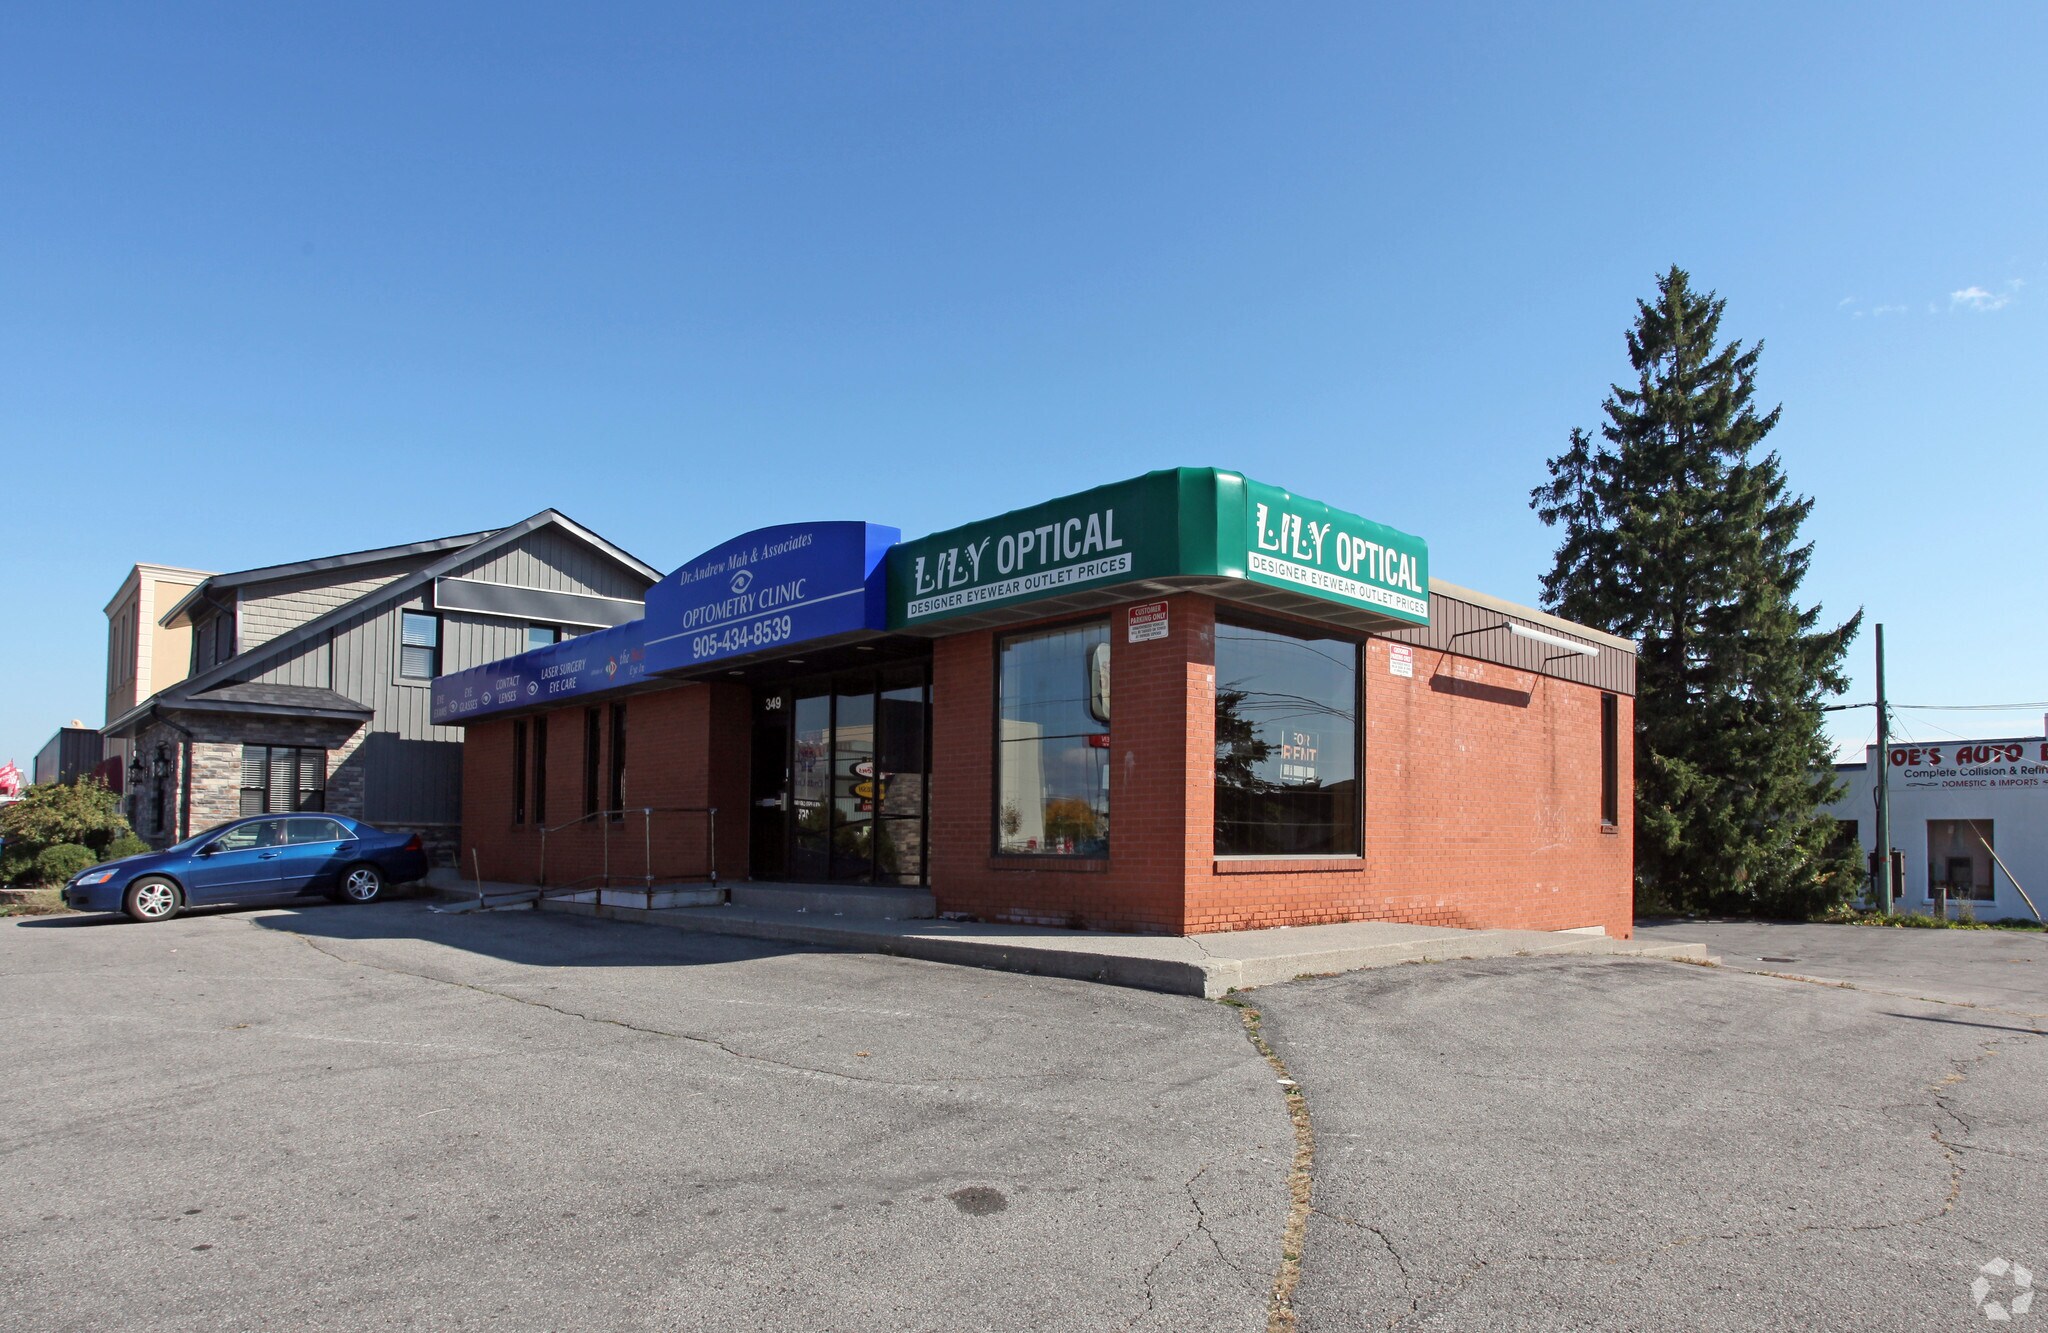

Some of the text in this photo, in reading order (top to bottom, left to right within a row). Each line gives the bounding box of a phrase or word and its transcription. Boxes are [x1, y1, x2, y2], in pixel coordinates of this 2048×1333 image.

[727, 551, 747, 571] Mah
[750, 547, 758, 563] &
[761, 533, 812, 560] Associates
[915, 509, 1122, 595] LILY OPTICAL
[1256, 503, 1422, 593] LILY OPTICAL
[911, 558, 1126, 614] DESIGNER EYEWEAR OUTLET PRICES
[1253, 557, 1425, 614] DESIGNER EYEWEAR OUTLET PRICES
[683, 578, 806, 628] OPTOMETRY CLINIC
[1135, 605, 1161, 616] CUSTOMER
[1130, 612, 1166, 624] PARKING ONLY
[693, 615, 791, 659] 905-434-8539
[541, 665, 558, 680] LASER
[559, 658, 586, 676] SURGERY
[496, 675, 520, 690] CONTACT
[550, 677, 577, 693] EYE CARE
[464, 687, 473, 698] EYE
[498, 690, 517, 704] LENSES
[460, 699, 478, 712] GLASSES
[766, 697, 781, 710] 349
[1956, 744, 2023, 766] AUTO
[1904, 768, 1956, 778] Complete
[1960, 766, 2005, 776] Collision
[2010, 766, 2017, 775] &
[1942, 780, 1986, 788] DOMESTIC
[1999, 779, 2038, 787] IMPORTS
